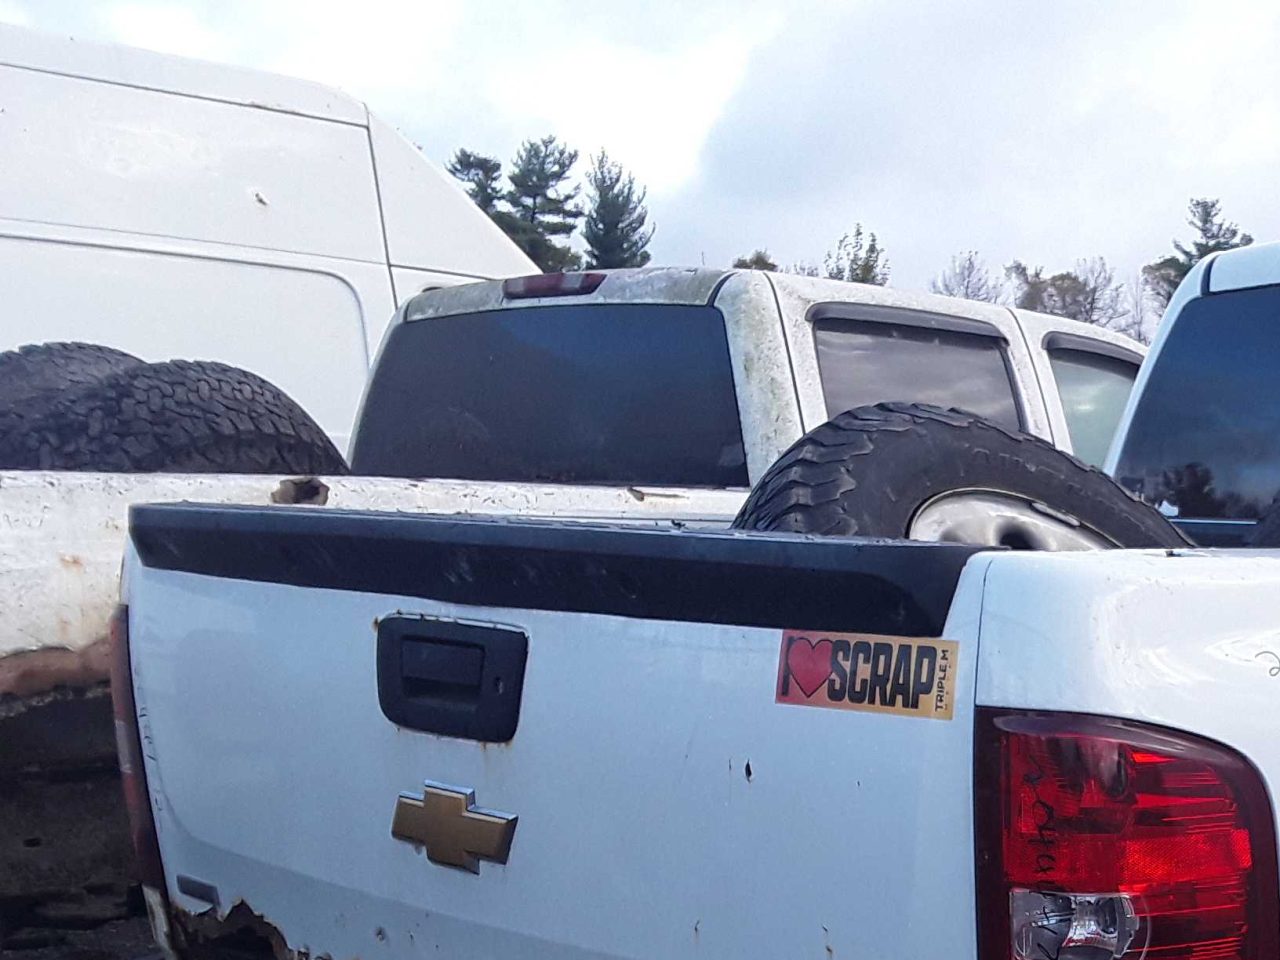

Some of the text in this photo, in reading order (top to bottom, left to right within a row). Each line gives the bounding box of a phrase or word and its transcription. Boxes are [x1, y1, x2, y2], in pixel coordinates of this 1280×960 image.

[827, 639, 938, 710] SCRAP
[940, 648, 950, 661] M
[935, 664, 948, 712] TRIPLE
